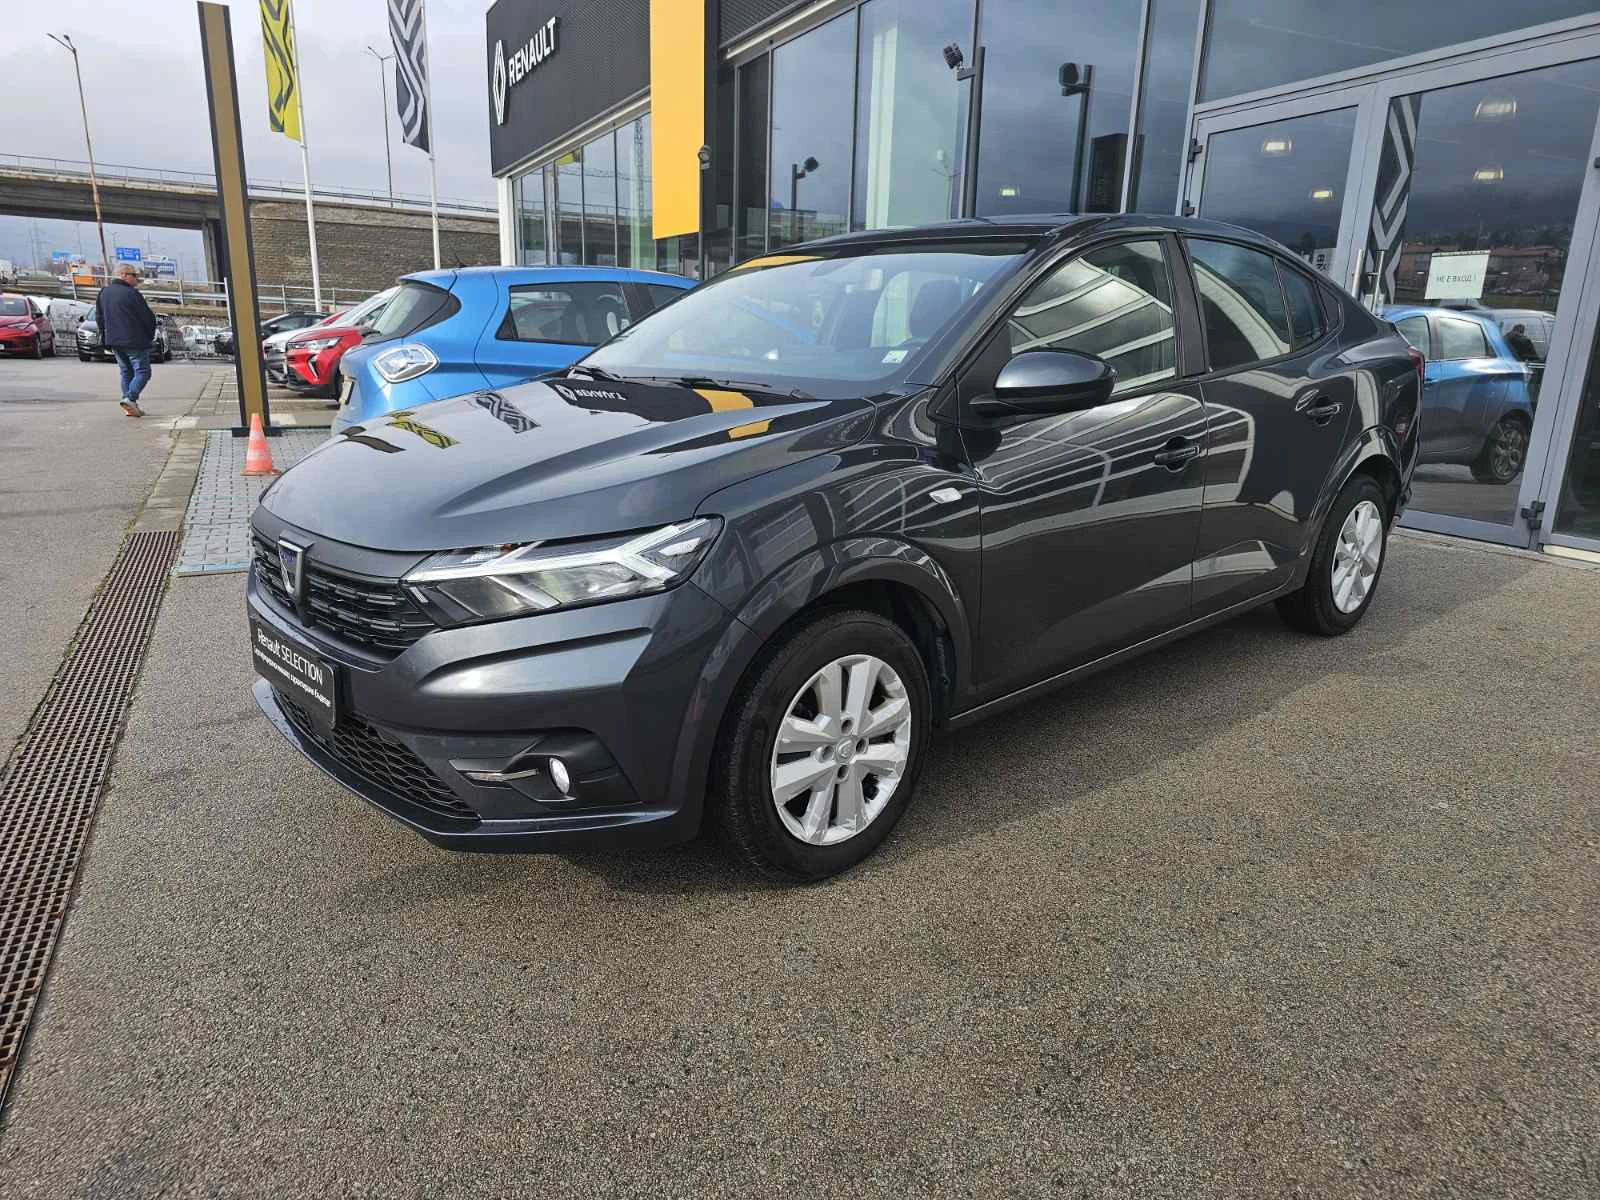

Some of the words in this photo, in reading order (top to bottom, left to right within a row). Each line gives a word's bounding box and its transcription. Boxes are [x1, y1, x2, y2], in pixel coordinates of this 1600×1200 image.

[508, 16, 556, 87] RENAULT
[257, 627, 281, 658] Renault
[281, 644, 323, 686] SELECTION
